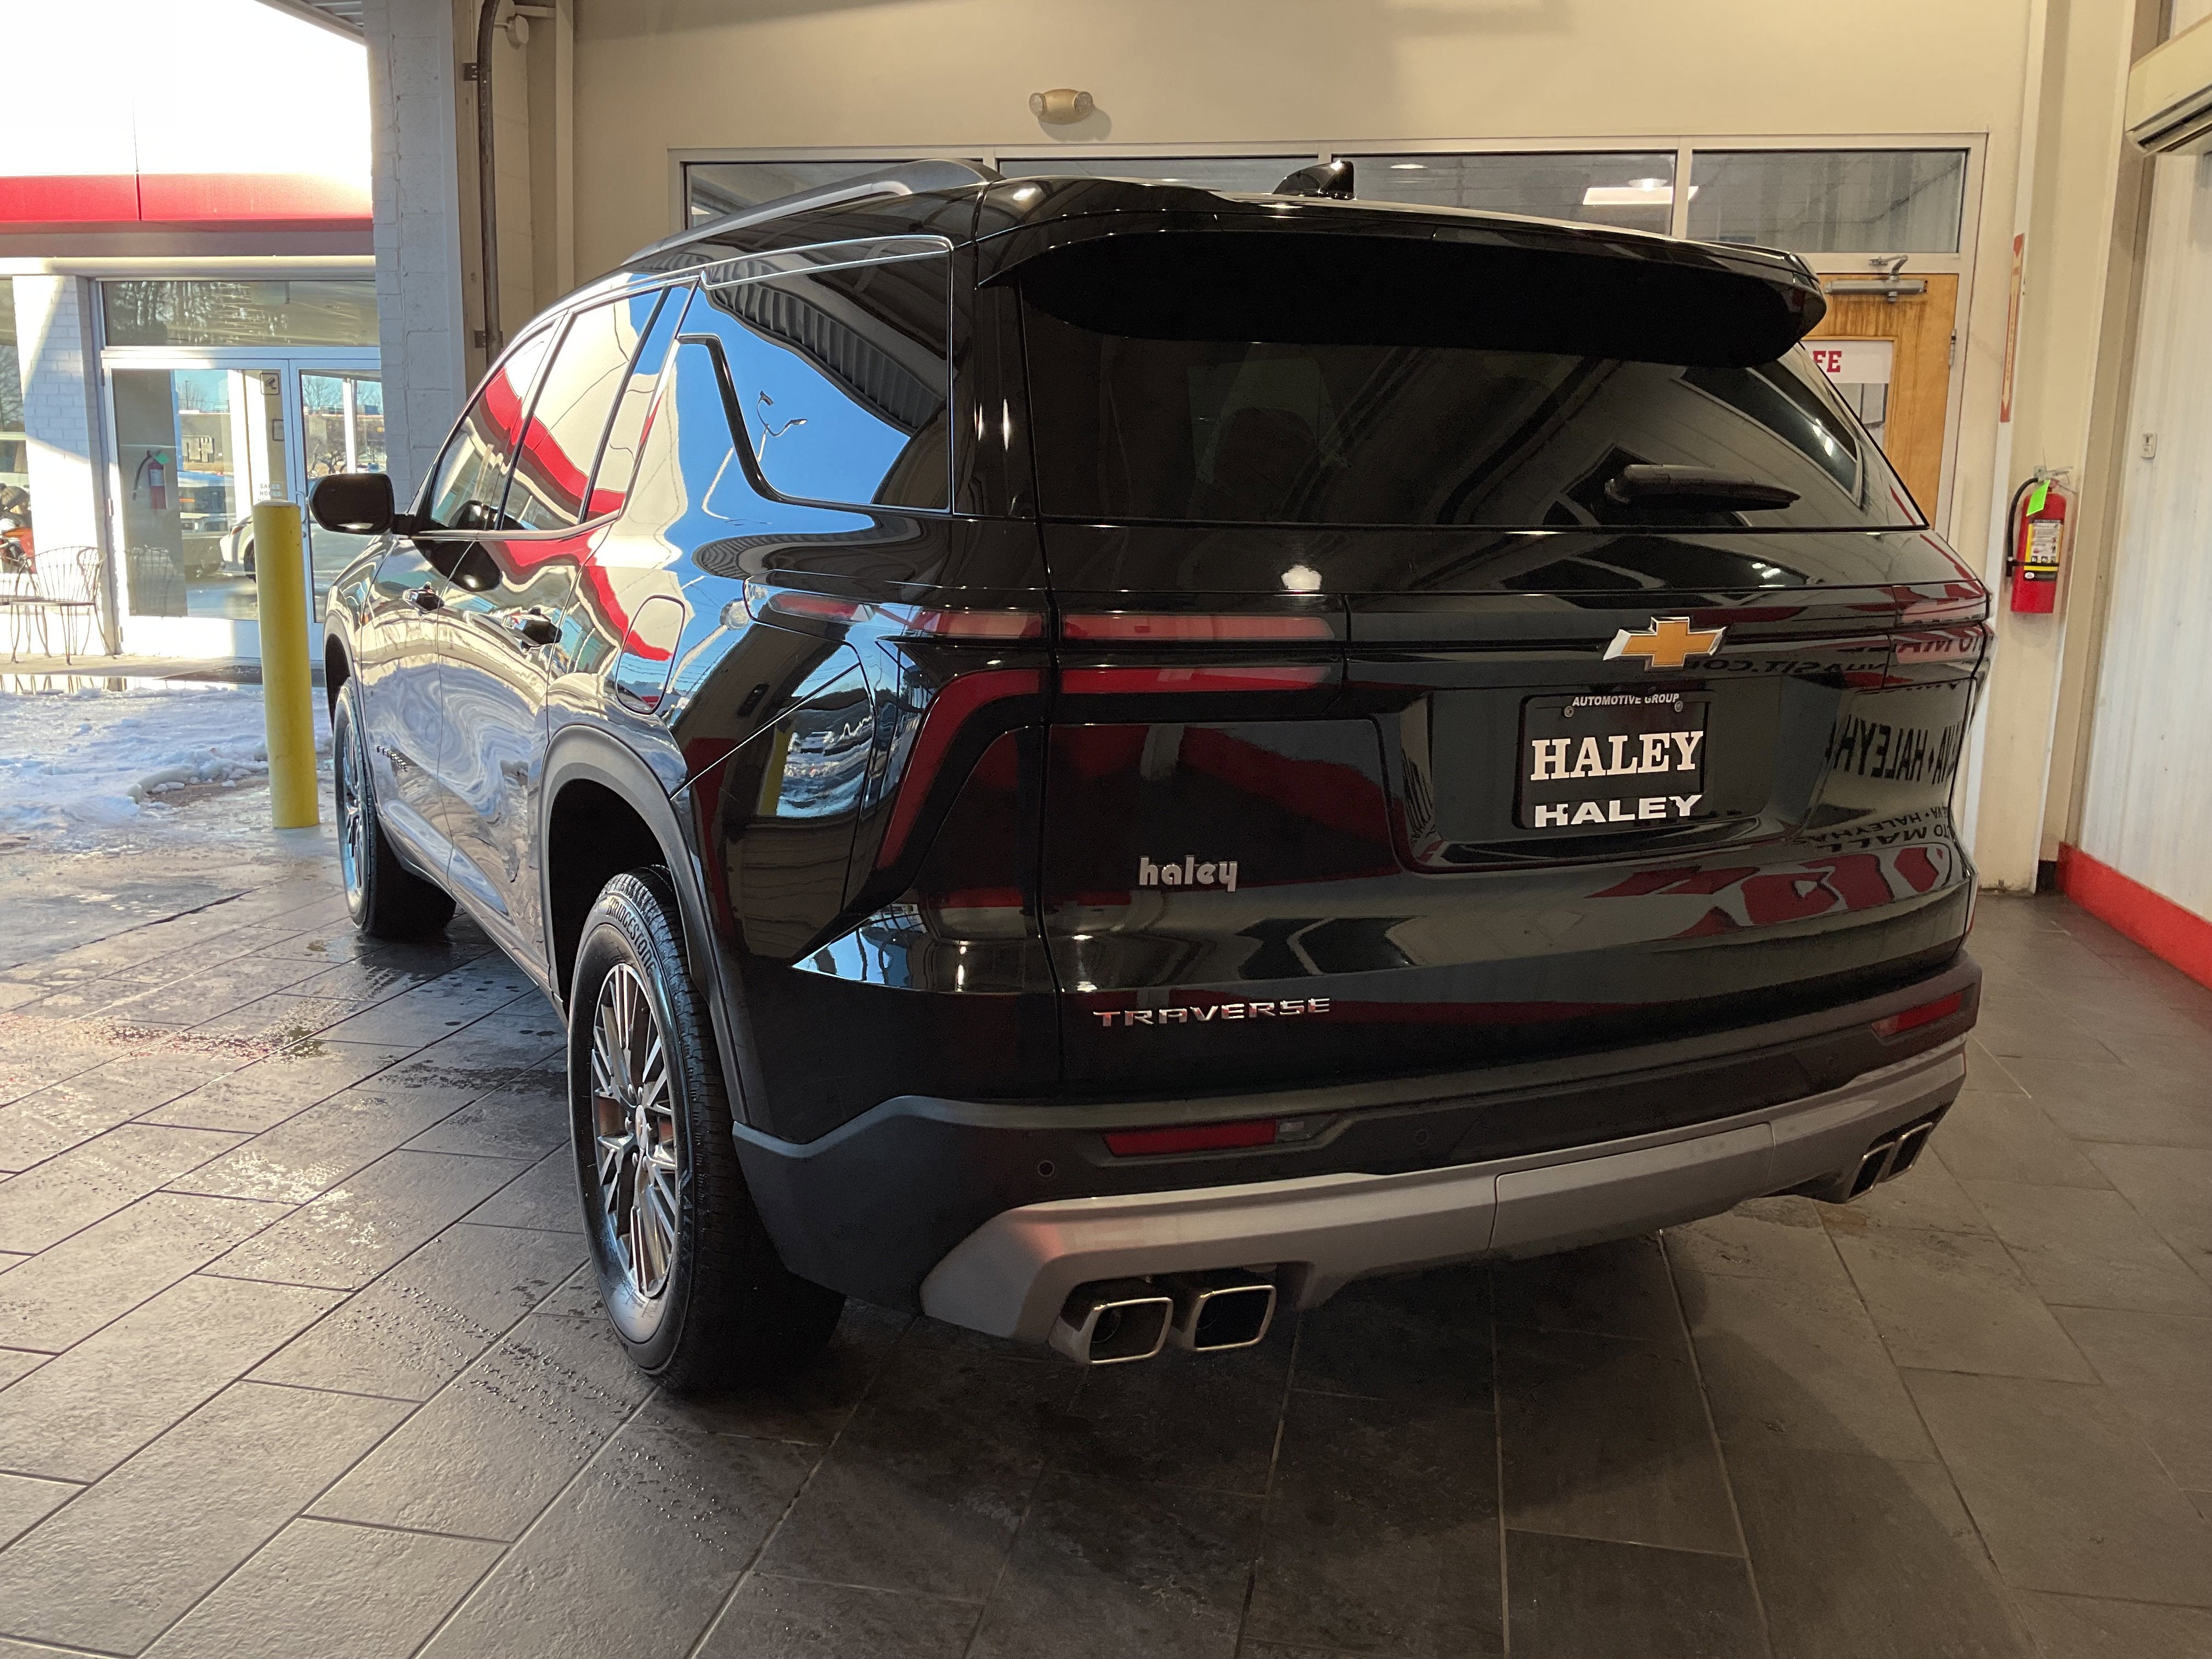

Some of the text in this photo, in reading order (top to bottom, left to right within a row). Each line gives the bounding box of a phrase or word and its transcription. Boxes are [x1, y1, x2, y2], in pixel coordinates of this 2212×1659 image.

[1572, 693, 1679, 707] AUTOMOTIVE GROUP
[1531, 730, 1703, 781] HALEY
[1535, 794, 1703, 828] HALEY
[1138, 854, 1238, 893] haley
[606, 896, 657, 978] BRIDGESTONE
[1093, 997, 1330, 1028] TRAVERSE
